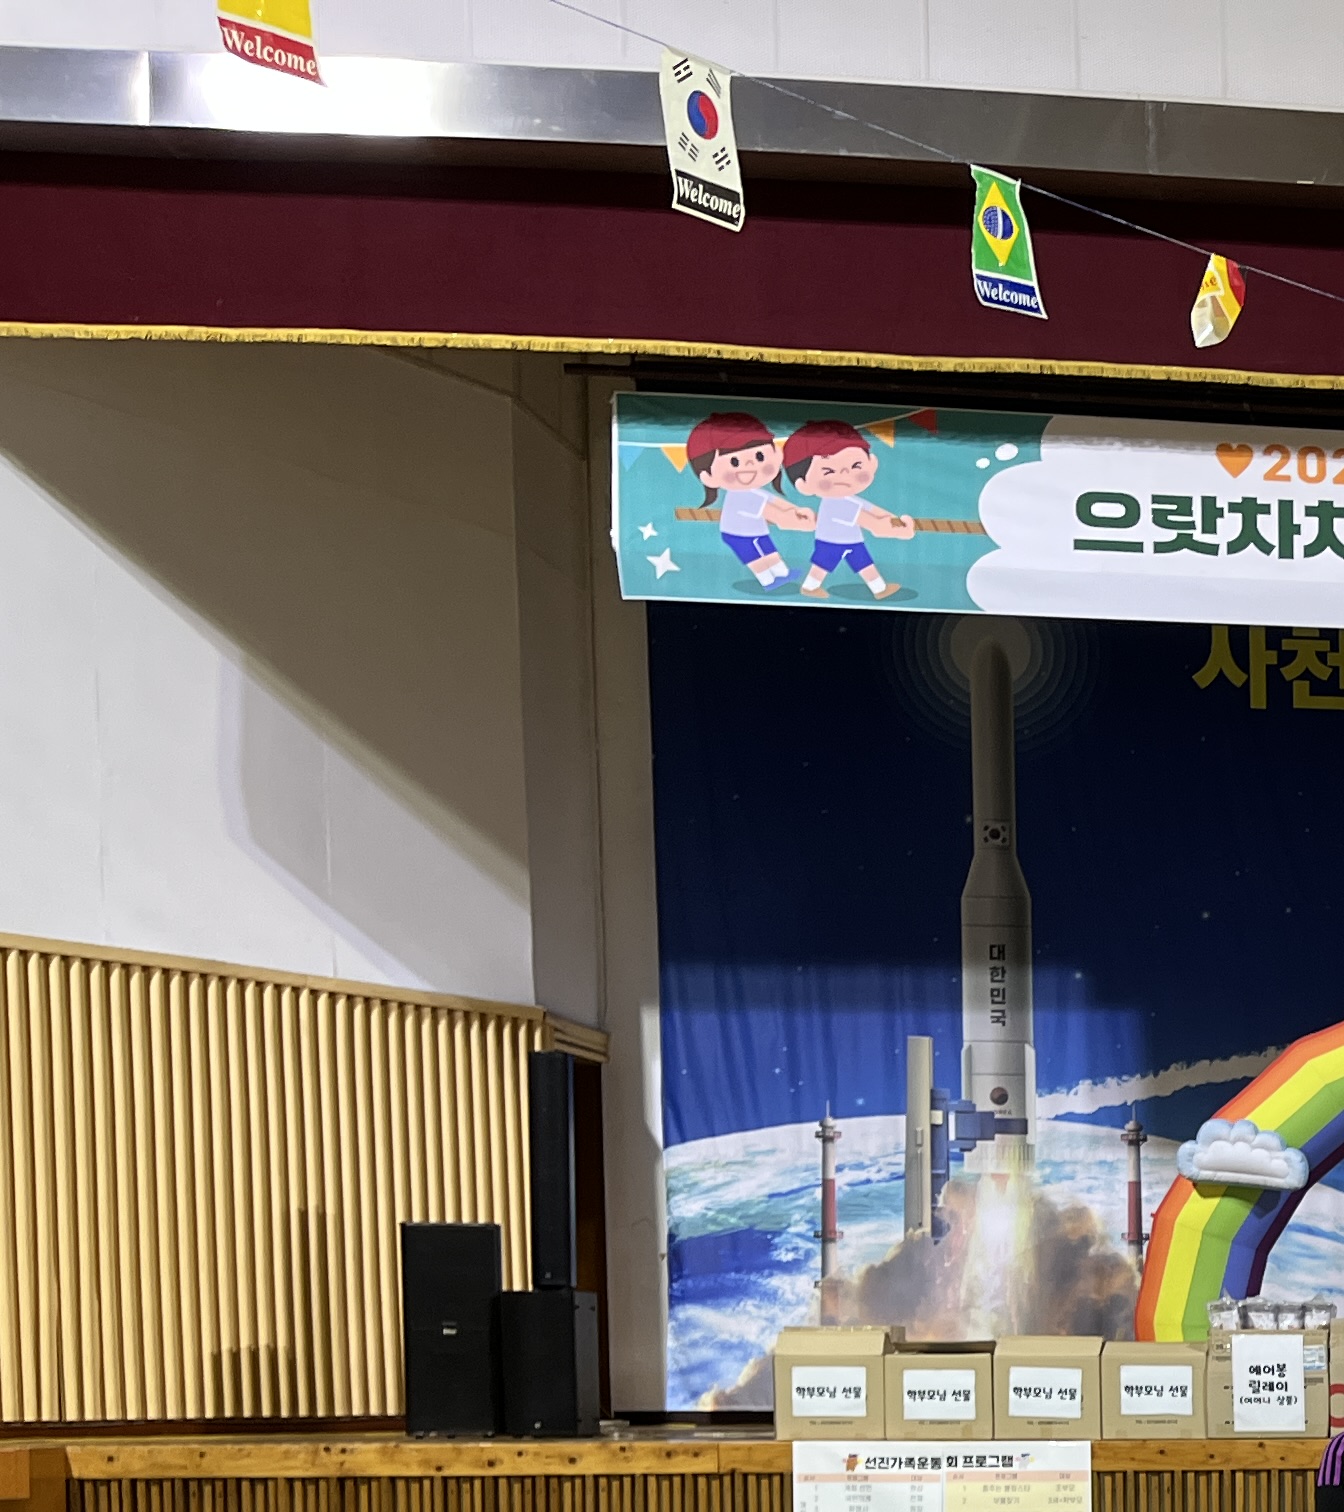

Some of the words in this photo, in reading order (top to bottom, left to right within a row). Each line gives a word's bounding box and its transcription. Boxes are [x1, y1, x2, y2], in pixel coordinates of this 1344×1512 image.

[222, 25, 318, 78] Welcome
[676, 177, 741, 219] Welcome
[977, 280, 1038, 309] Welcome
[988, 943, 1007, 1027] 대한민국
[1249, 1363, 1288, 1378] 에어봉
[795, 1385, 837, 1399] 학부모님
[842, 1384, 863, 1398] 선물
[1013, 1385, 1053, 1399] 학부모님
[1058, 1386, 1077, 1400] 선물
[1124, 1384, 1165, 1398] 학부모님
[1168, 1384, 1188, 1398] 선물
[1249, 1380, 1289, 1394] 릴레이
[906, 1388, 947, 1402] 학부모님
[951, 1388, 971, 1402] 선물
[865, 1455, 958, 1470] 선진가족운동회
[962, 1455, 1014, 1468] 프로그램
